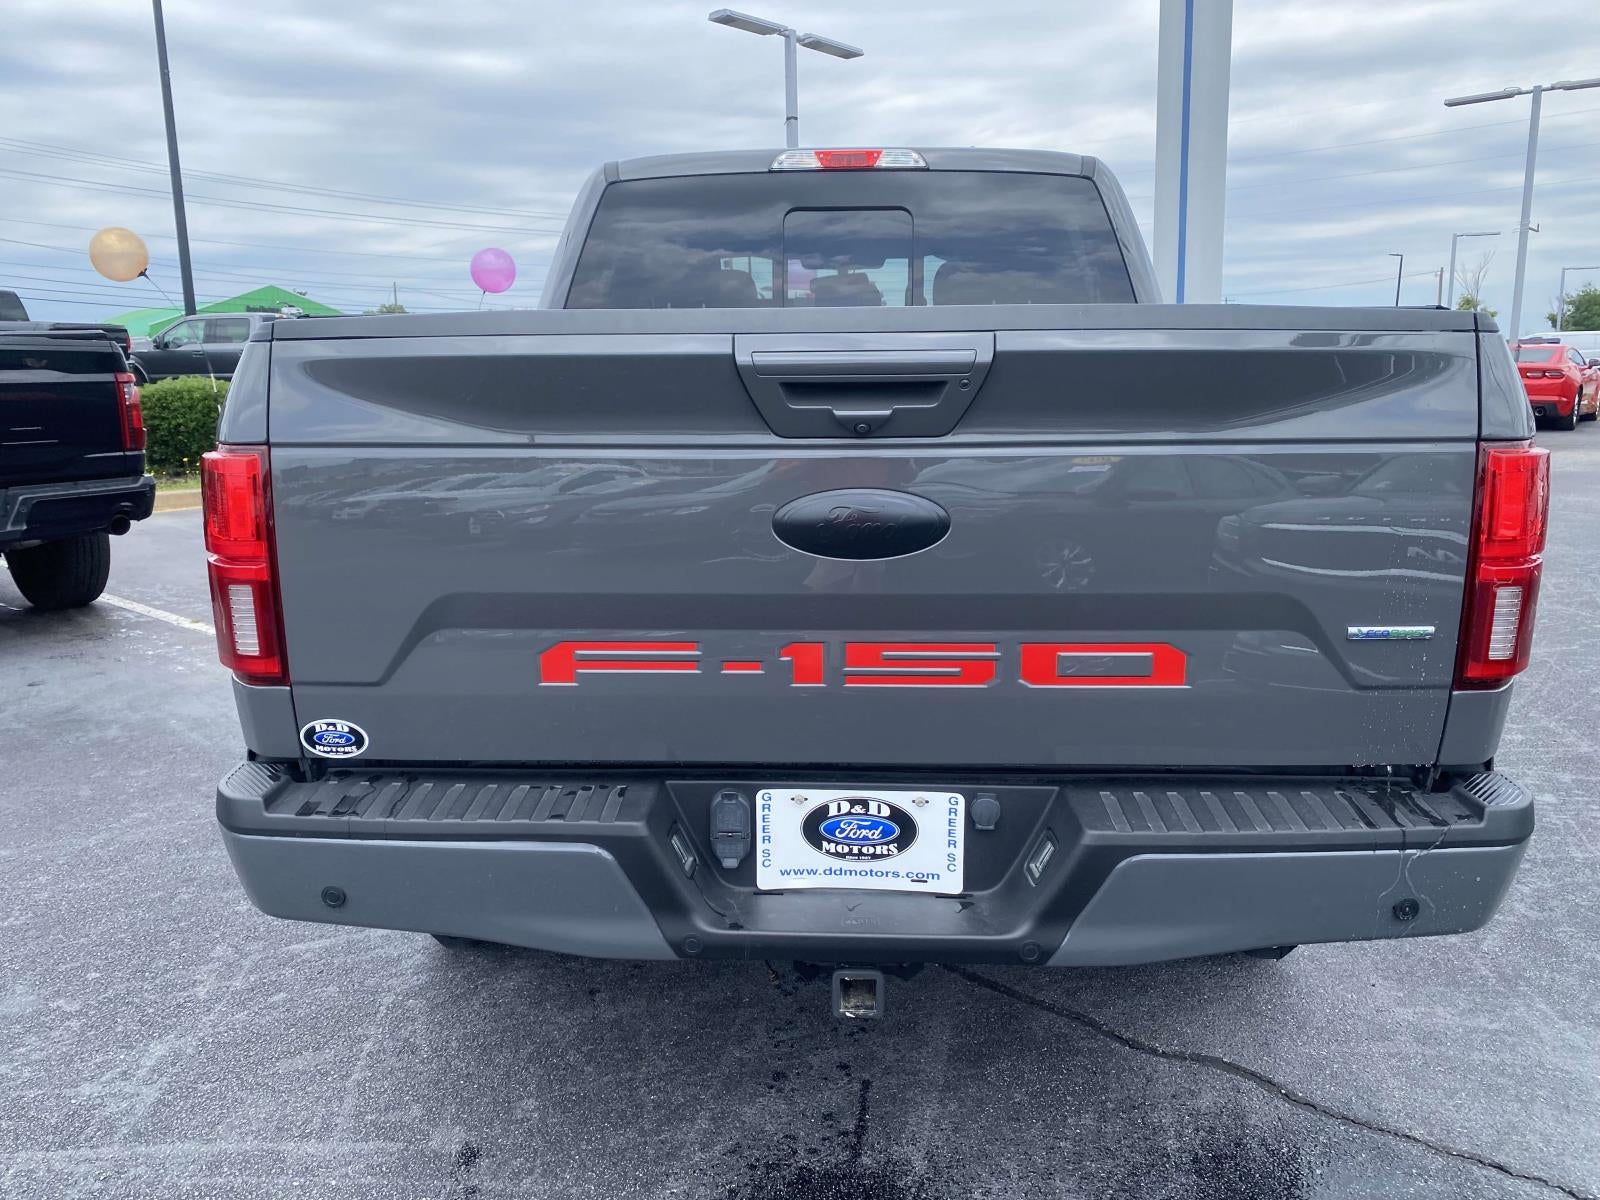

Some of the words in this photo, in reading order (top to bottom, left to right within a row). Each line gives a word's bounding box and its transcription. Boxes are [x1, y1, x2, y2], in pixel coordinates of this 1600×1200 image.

[817, 505, 899, 542] Ford
[538, 641, 1192, 688] F-150
[314, 723, 350, 732] D&D
[322, 733, 347, 743] Ford
[761, 792, 772, 844] GREER
[827, 800, 891, 818] D&D
[835, 819, 882, 838] Ford
[947, 796, 959, 848] GREER
[822, 841, 899, 855] MOTORS
[761, 848, 772, 868] SC
[946, 852, 957, 873] SC
[779, 866, 940, 881] www.ddmotors.com
